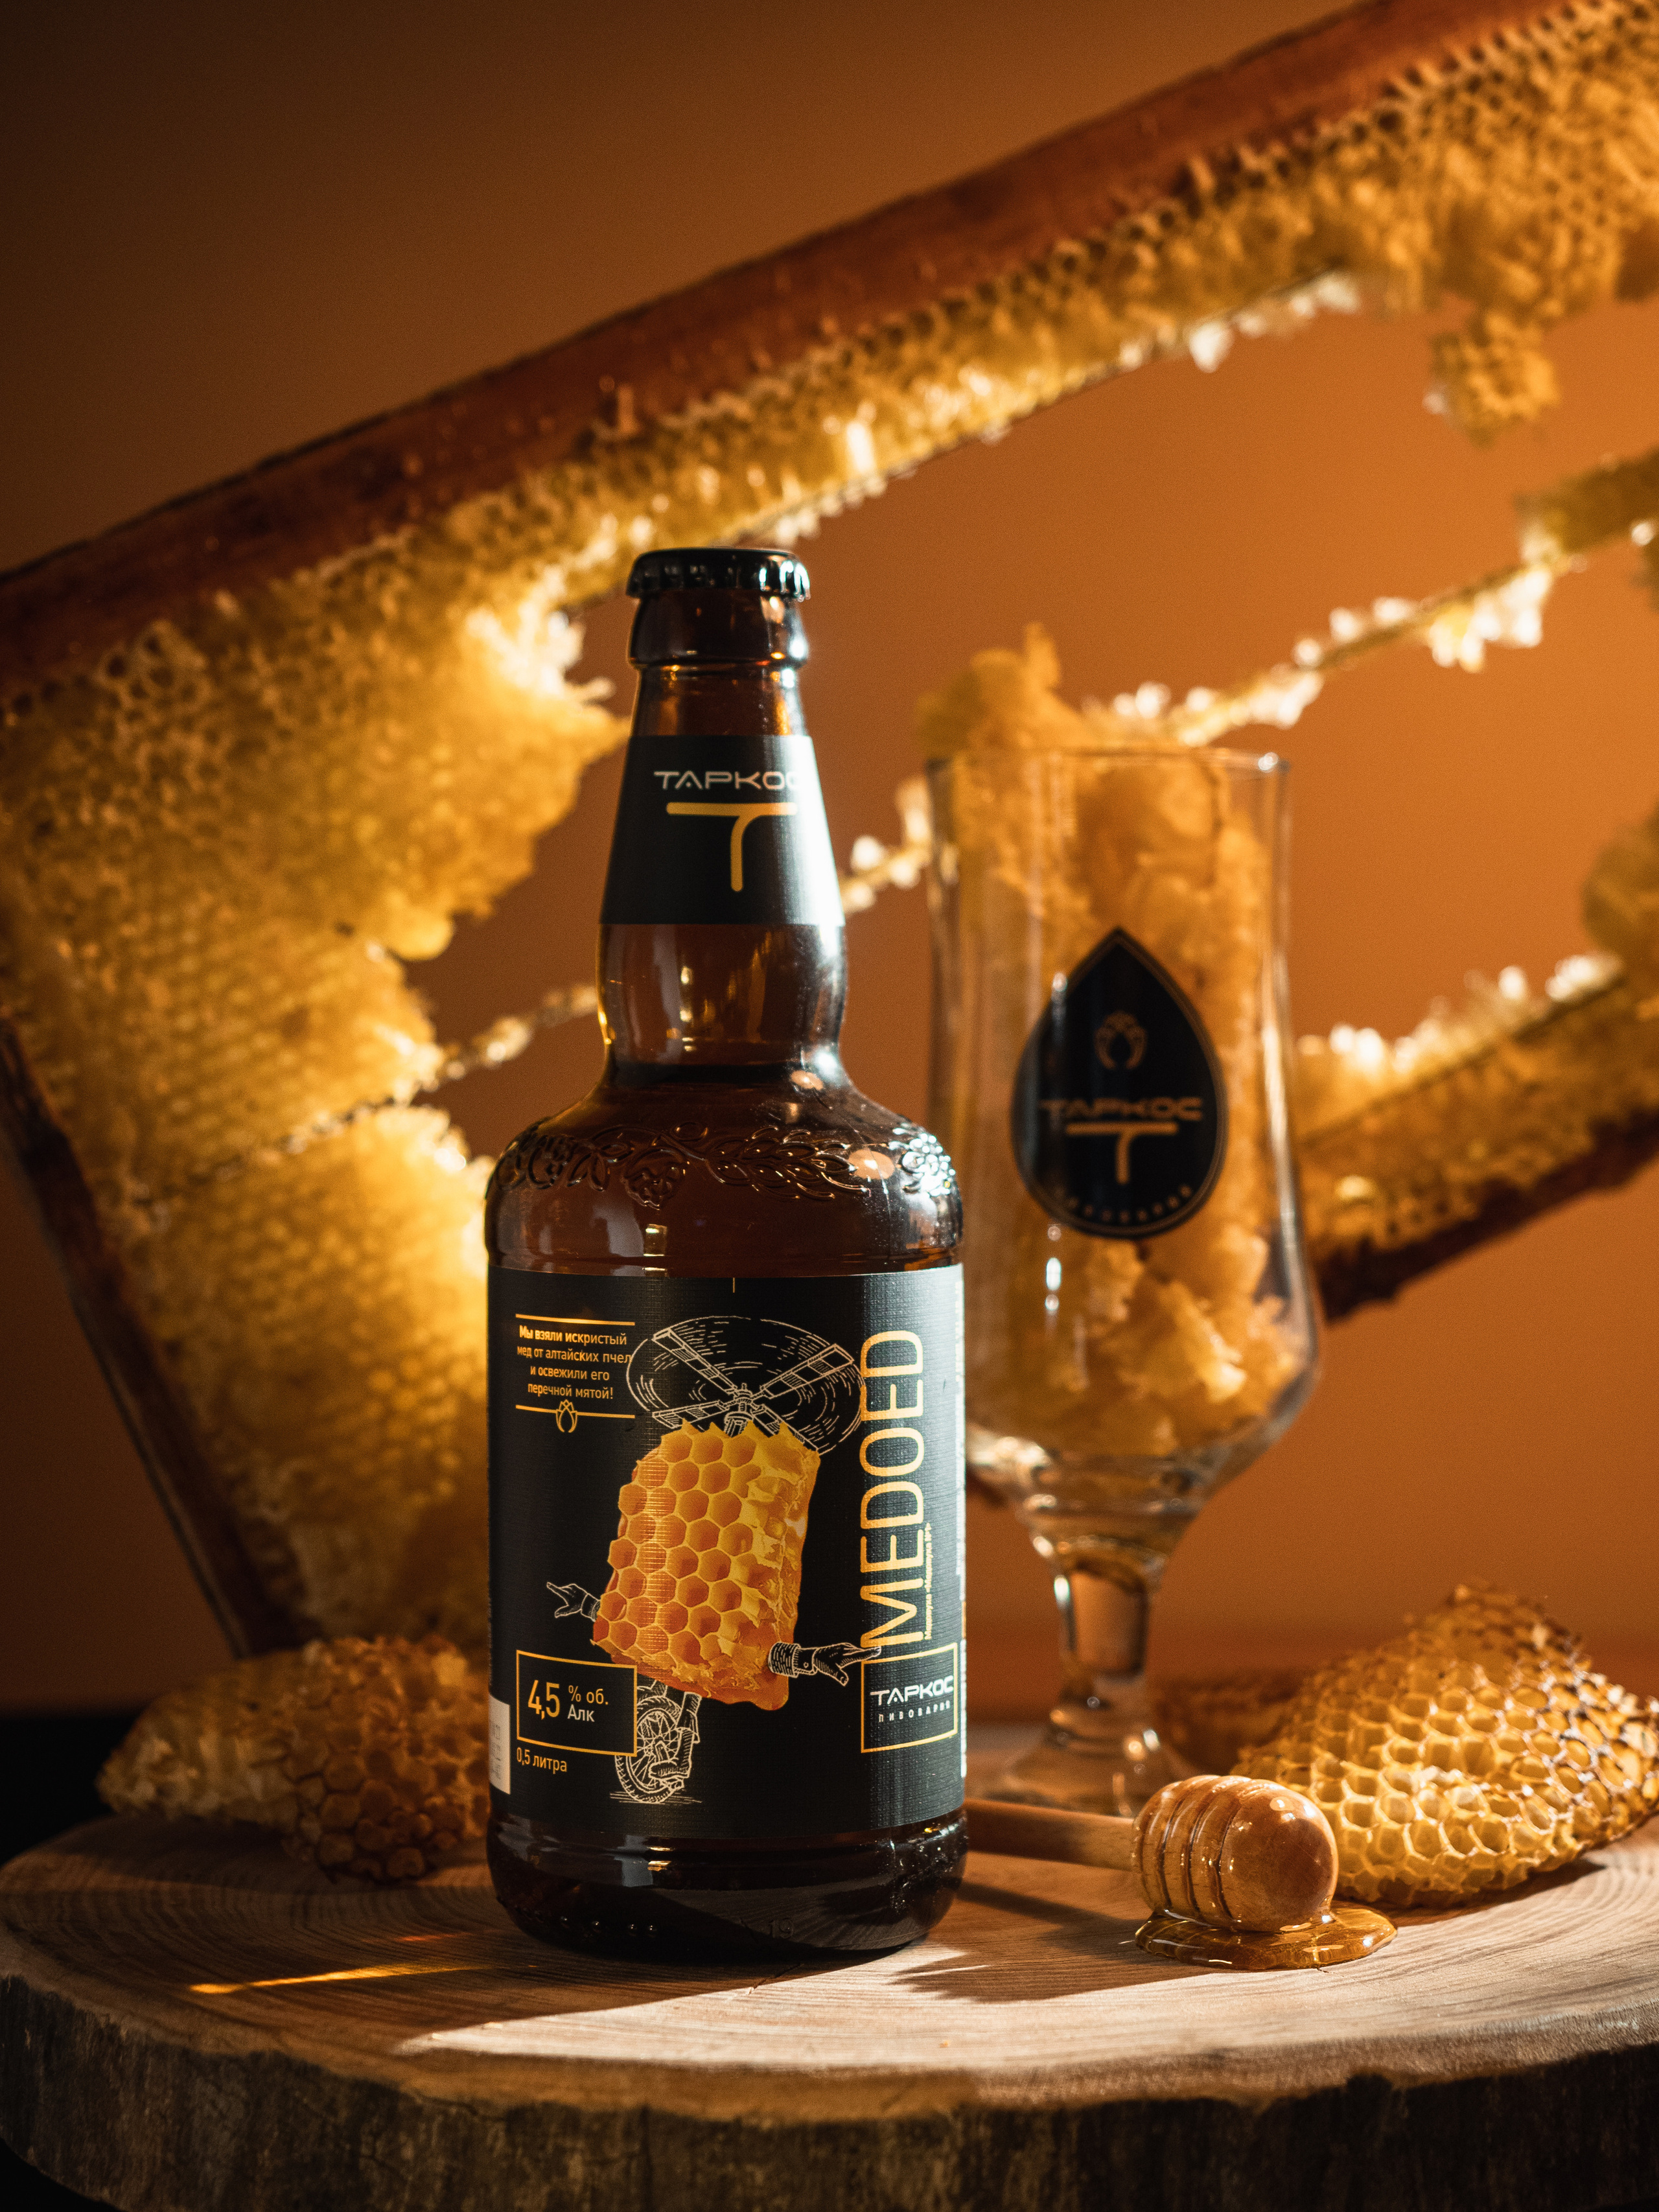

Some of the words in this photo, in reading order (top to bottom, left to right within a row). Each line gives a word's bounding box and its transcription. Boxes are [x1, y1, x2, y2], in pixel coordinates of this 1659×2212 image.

[519, 1325, 533, 1339] Мы
[535, 1329, 563, 1342] взяли
[565, 1333, 627, 1346] искристый
[517, 1346, 532, 1358] мед
[534, 1348, 543, 1358] от
[546, 1349, 599, 1362] алтайских
[603, 1354, 632, 1363] пчел
[530, 1366, 535, 1375] и
[538, 1367, 587, 1380] освежили
[591, 1371, 609, 1380] его
[528, 1383, 572, 1397] перечной
[575, 1387, 613, 1399] мятой!
[859, 1330, 924, 1648] MEDOED
[528, 1680, 560, 1720] 4,5
[568, 1685, 581, 1702] %
[586, 1688, 609, 1705] об.
[870, 1675, 954, 1706] ТАРКОС
[568, 1704, 595, 1722] Алк
[516, 1747, 530, 1765] 0,5
[533, 1755, 567, 1774] литра
